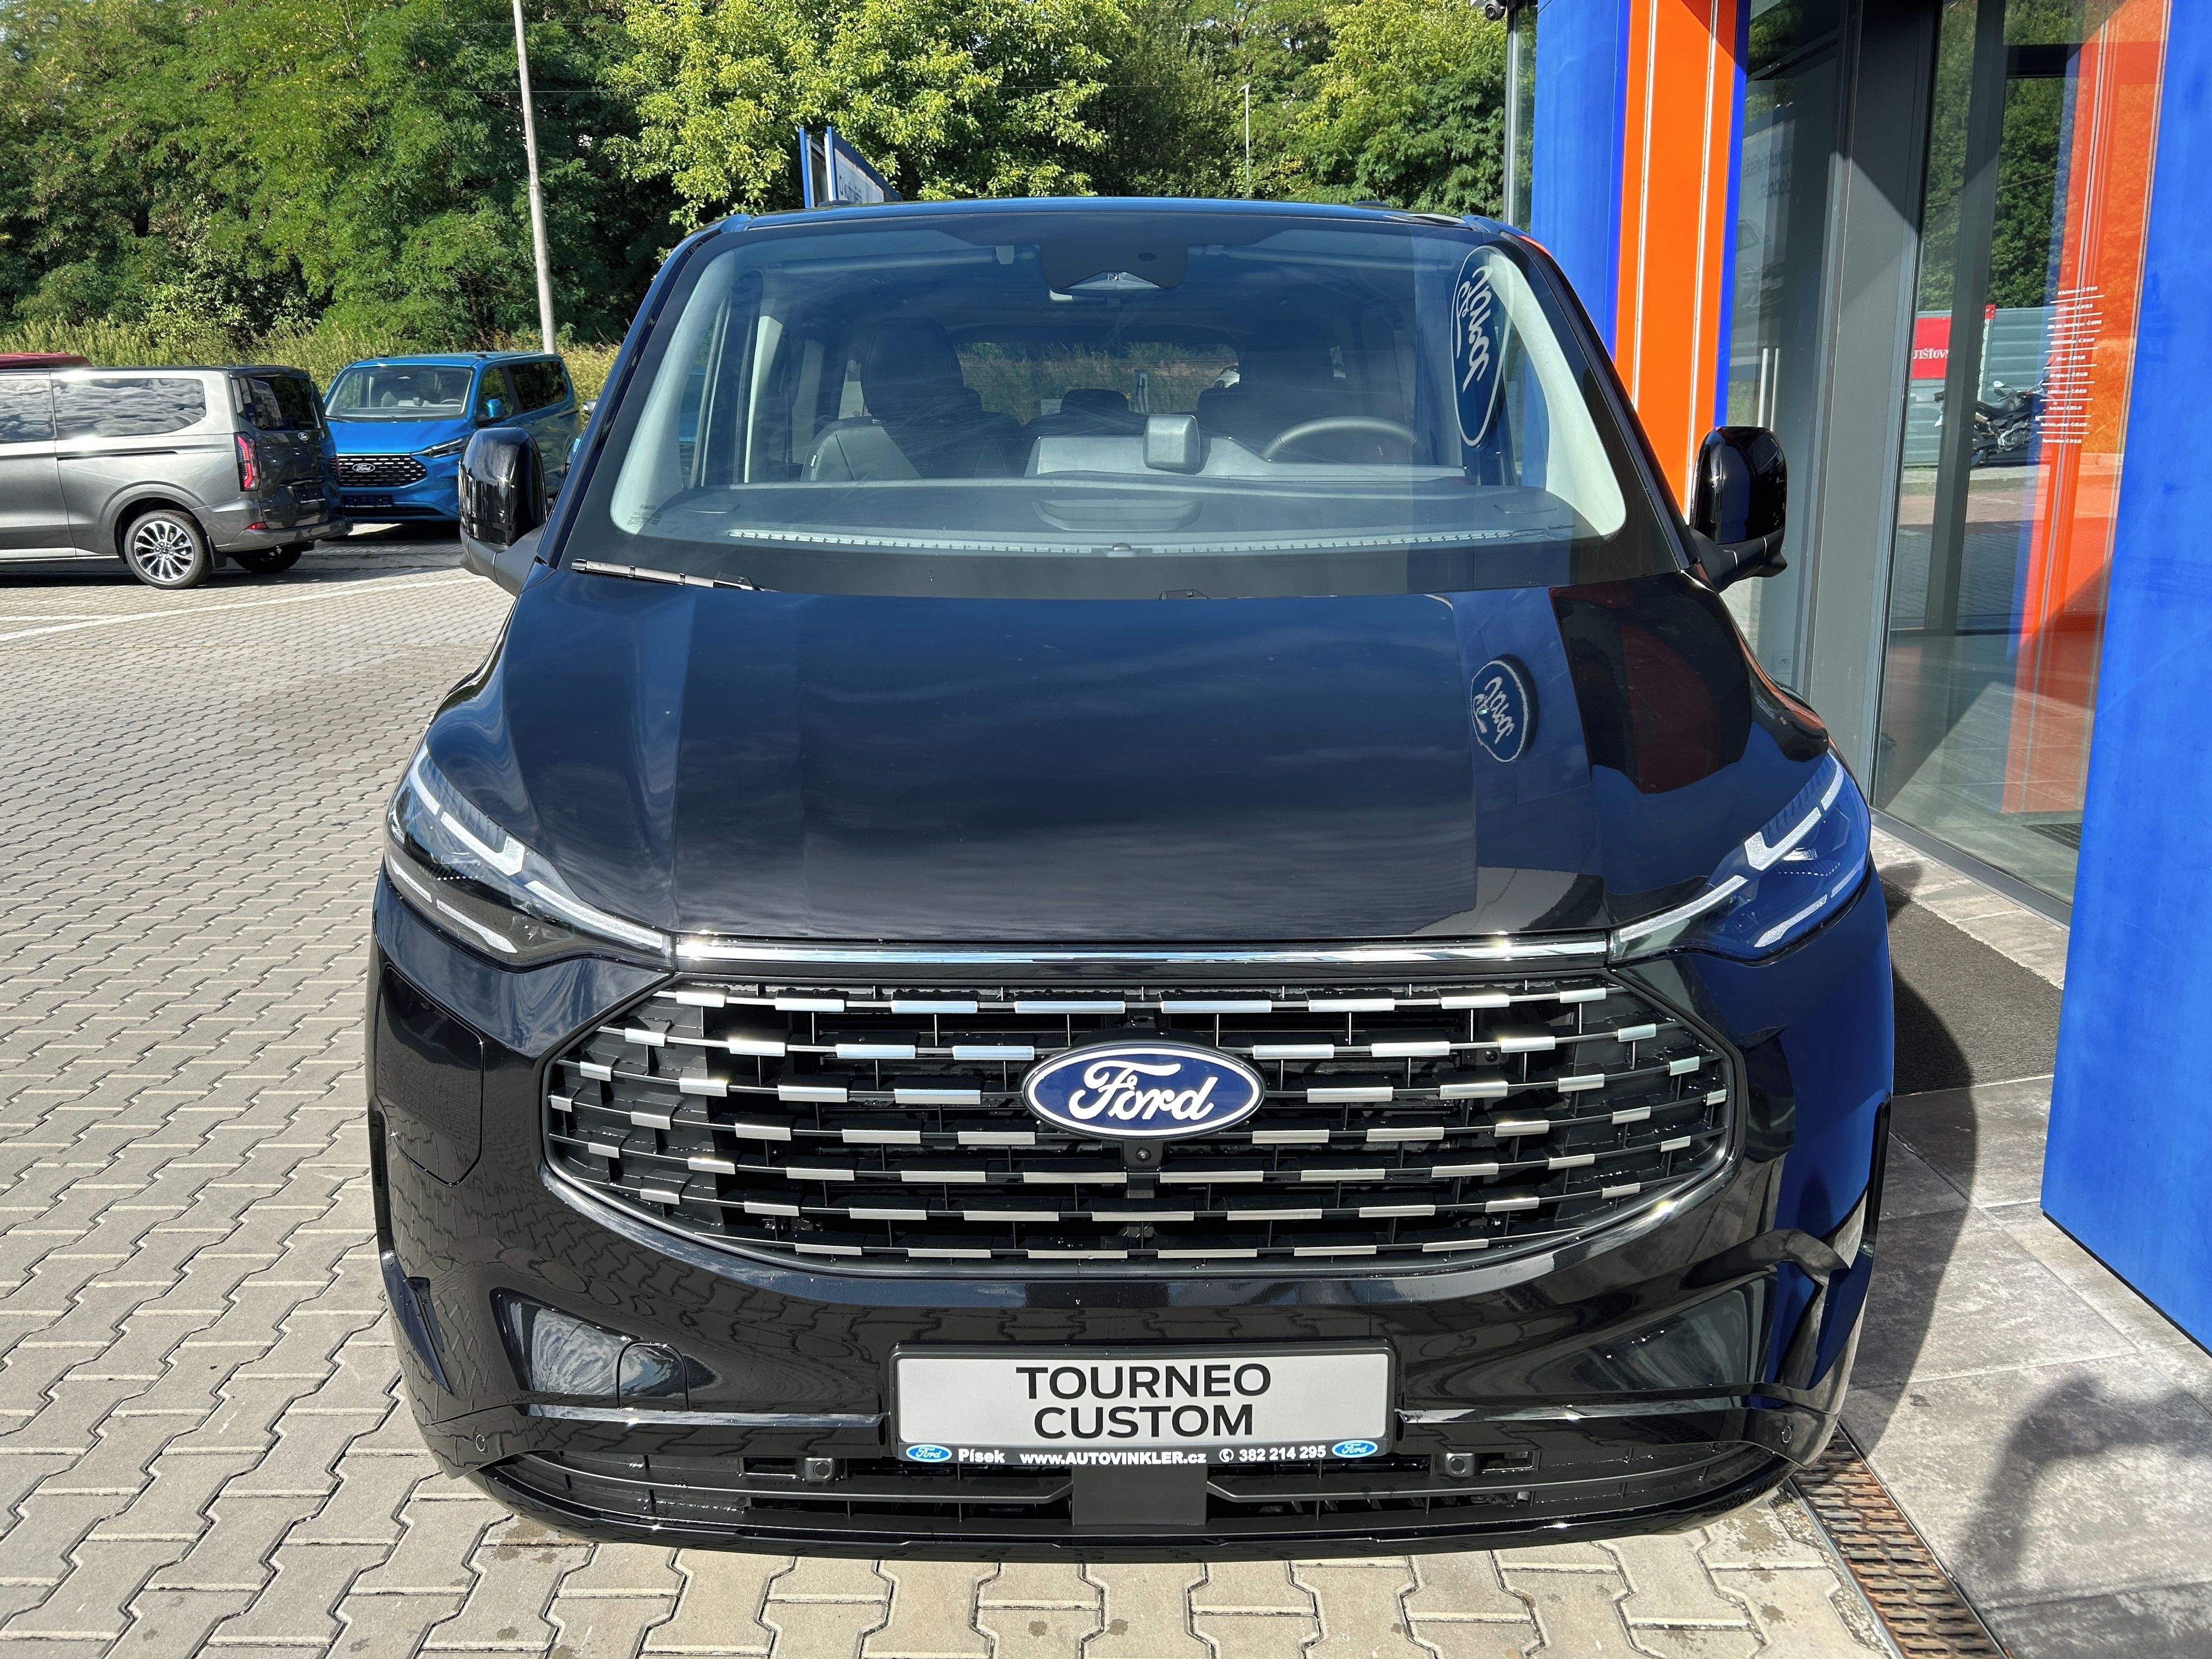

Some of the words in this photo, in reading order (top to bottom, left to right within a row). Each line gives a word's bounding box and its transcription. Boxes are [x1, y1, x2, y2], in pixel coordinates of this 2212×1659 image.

[1068, 1060, 1218, 1120] Ford
[1016, 1363, 1271, 1399] TOURNEO
[1034, 1404, 1252, 1438] CUSTOM
[915, 1447, 942, 1459] Ford
[958, 1448, 1005, 1463] Písek
[1020, 1451, 1206, 1465] www.AUTOVINKLER.cz
[1239, 1448, 1266, 1462] 382
[1269, 1447, 1296, 1460] 214
[1299, 1445, 1326, 1459] 295
[1342, 1443, 1368, 1455] Ford
